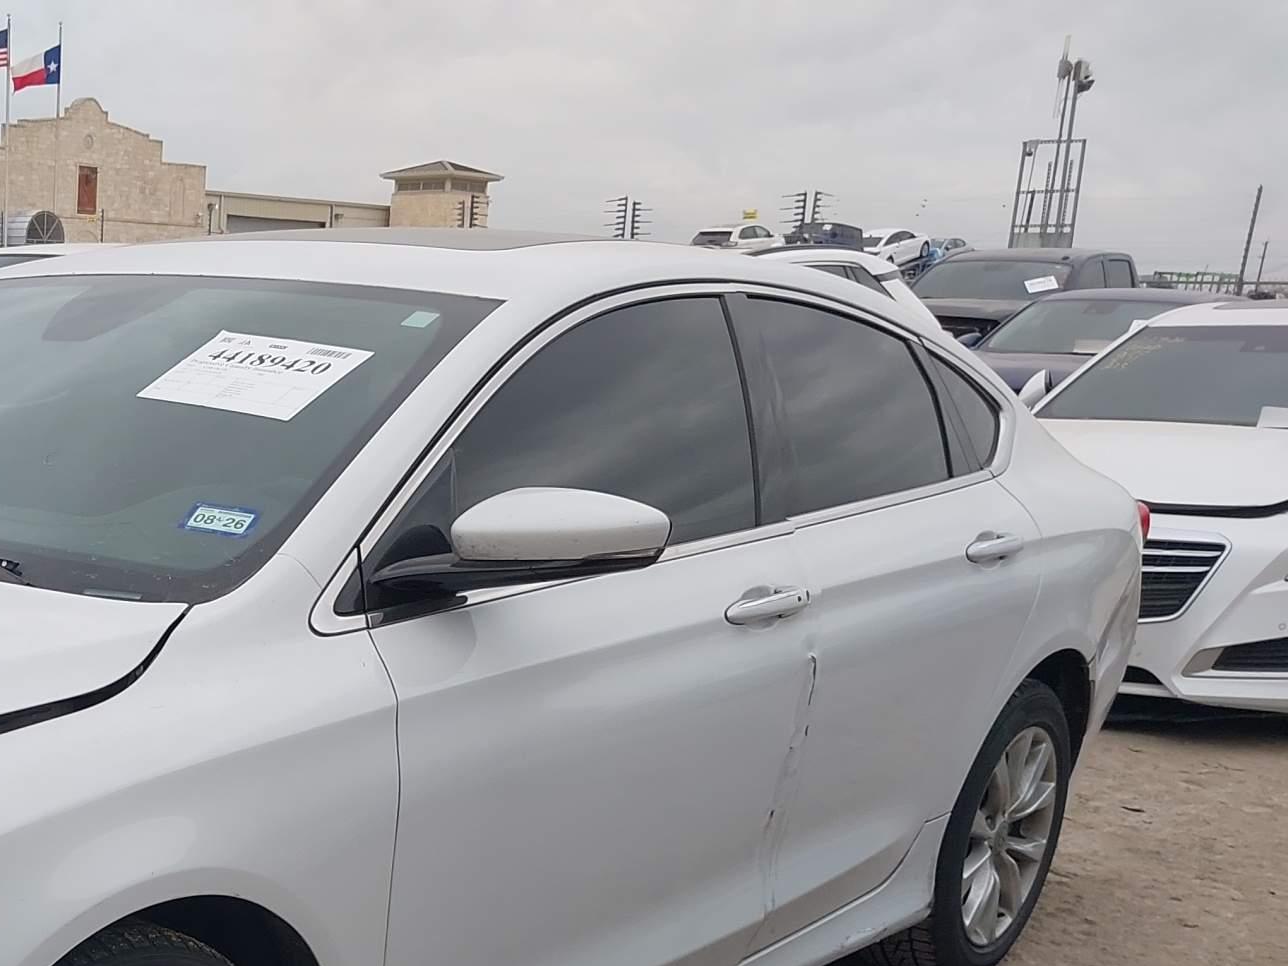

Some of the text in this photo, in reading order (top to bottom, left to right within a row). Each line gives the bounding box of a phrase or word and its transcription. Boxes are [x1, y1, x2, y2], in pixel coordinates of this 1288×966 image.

[208, 349, 331, 375] 44189420
[193, 513, 217, 525] 08
[222, 518, 246, 530] 26
